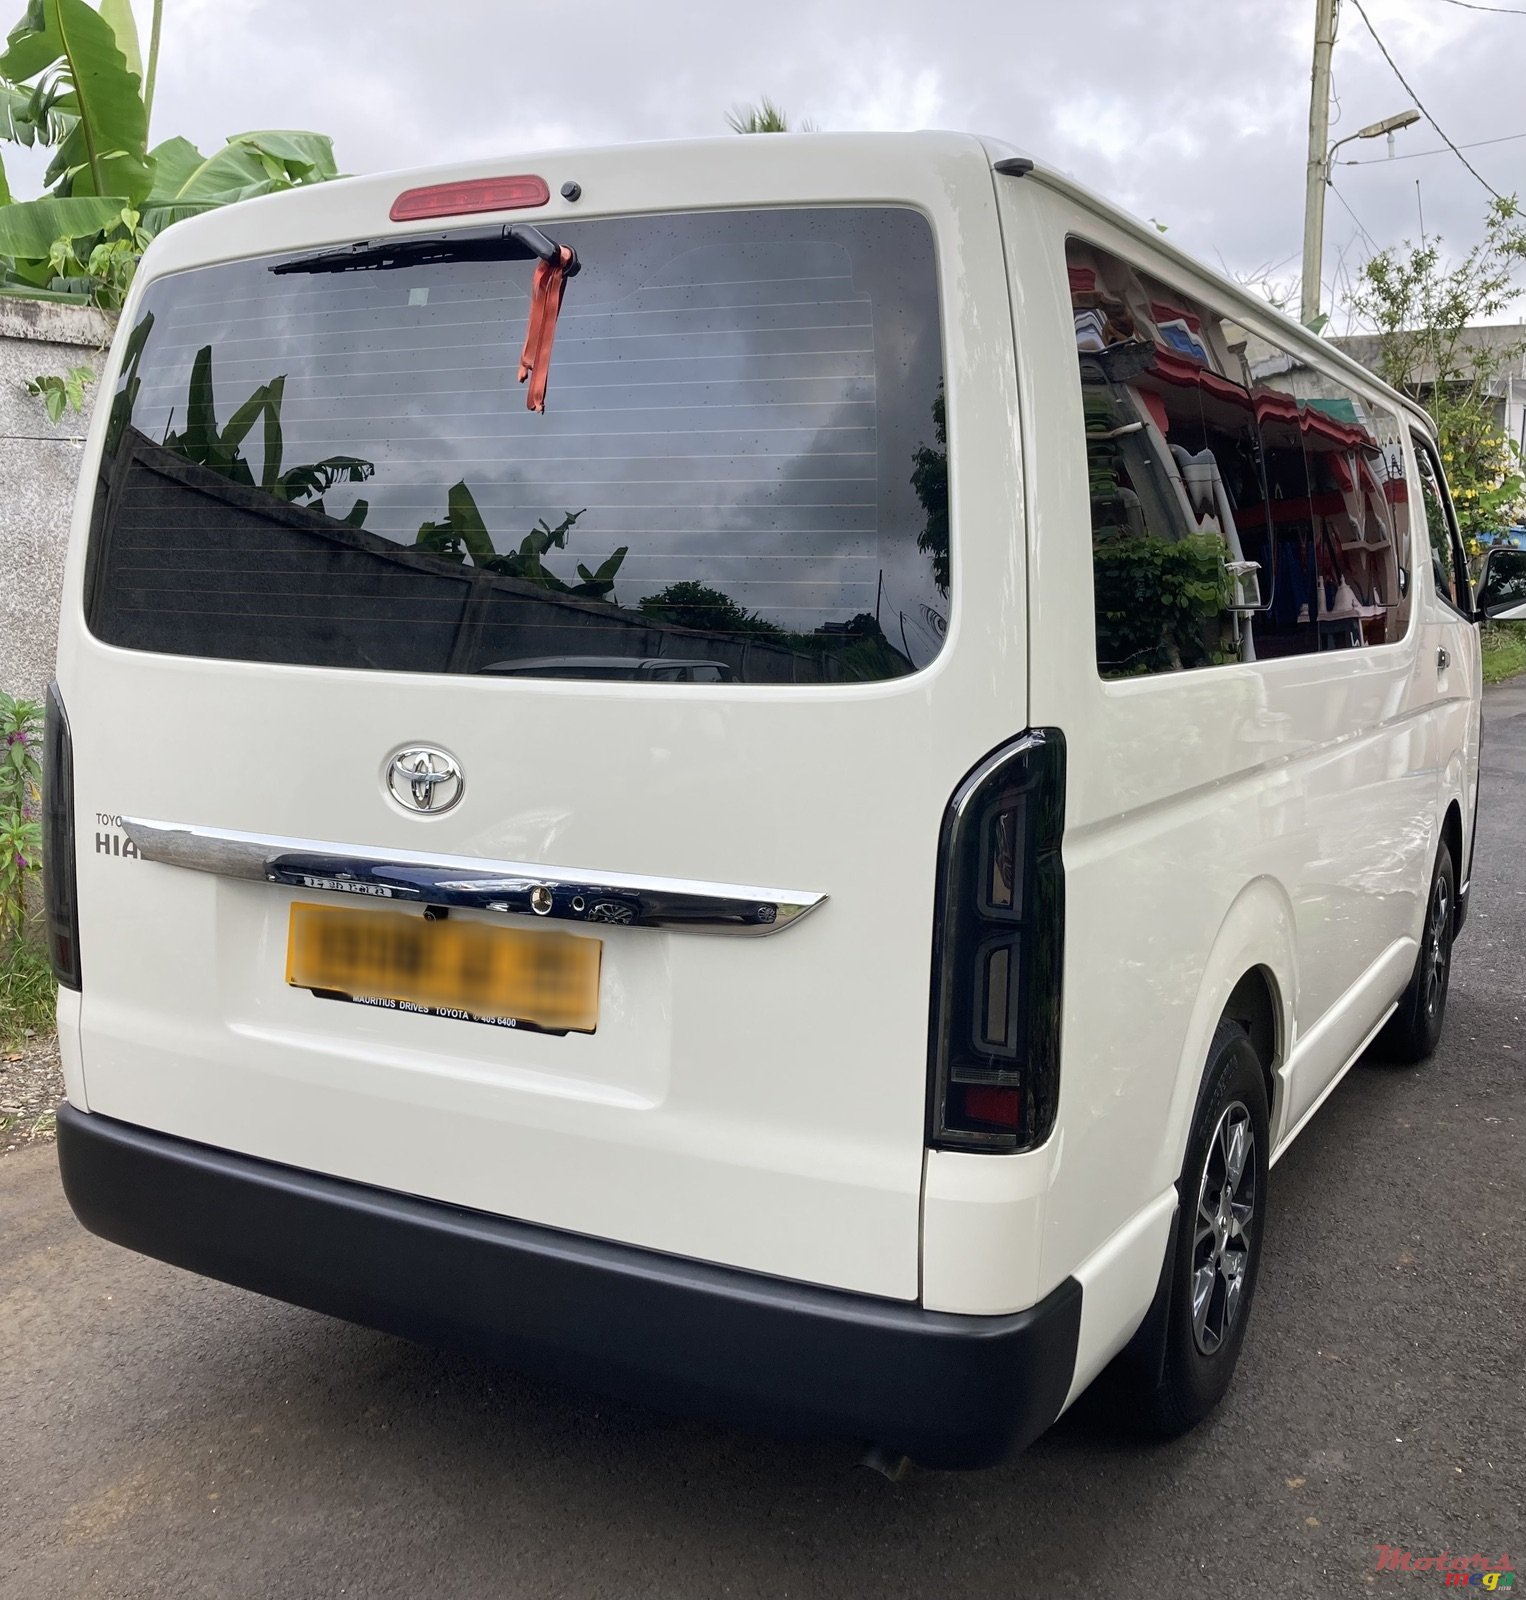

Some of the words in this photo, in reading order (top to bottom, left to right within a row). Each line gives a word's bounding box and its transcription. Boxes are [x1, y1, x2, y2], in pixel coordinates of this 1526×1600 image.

[96, 813, 123, 828] TOYO
[95, 832, 144, 860] HIA
[352, 995, 396, 1008] MAURITIUS
[399, 1000, 429, 1013] DRIVES
[435, 1006, 469, 1020] TOYOTA
[497, 1016, 517, 1027] 6400
